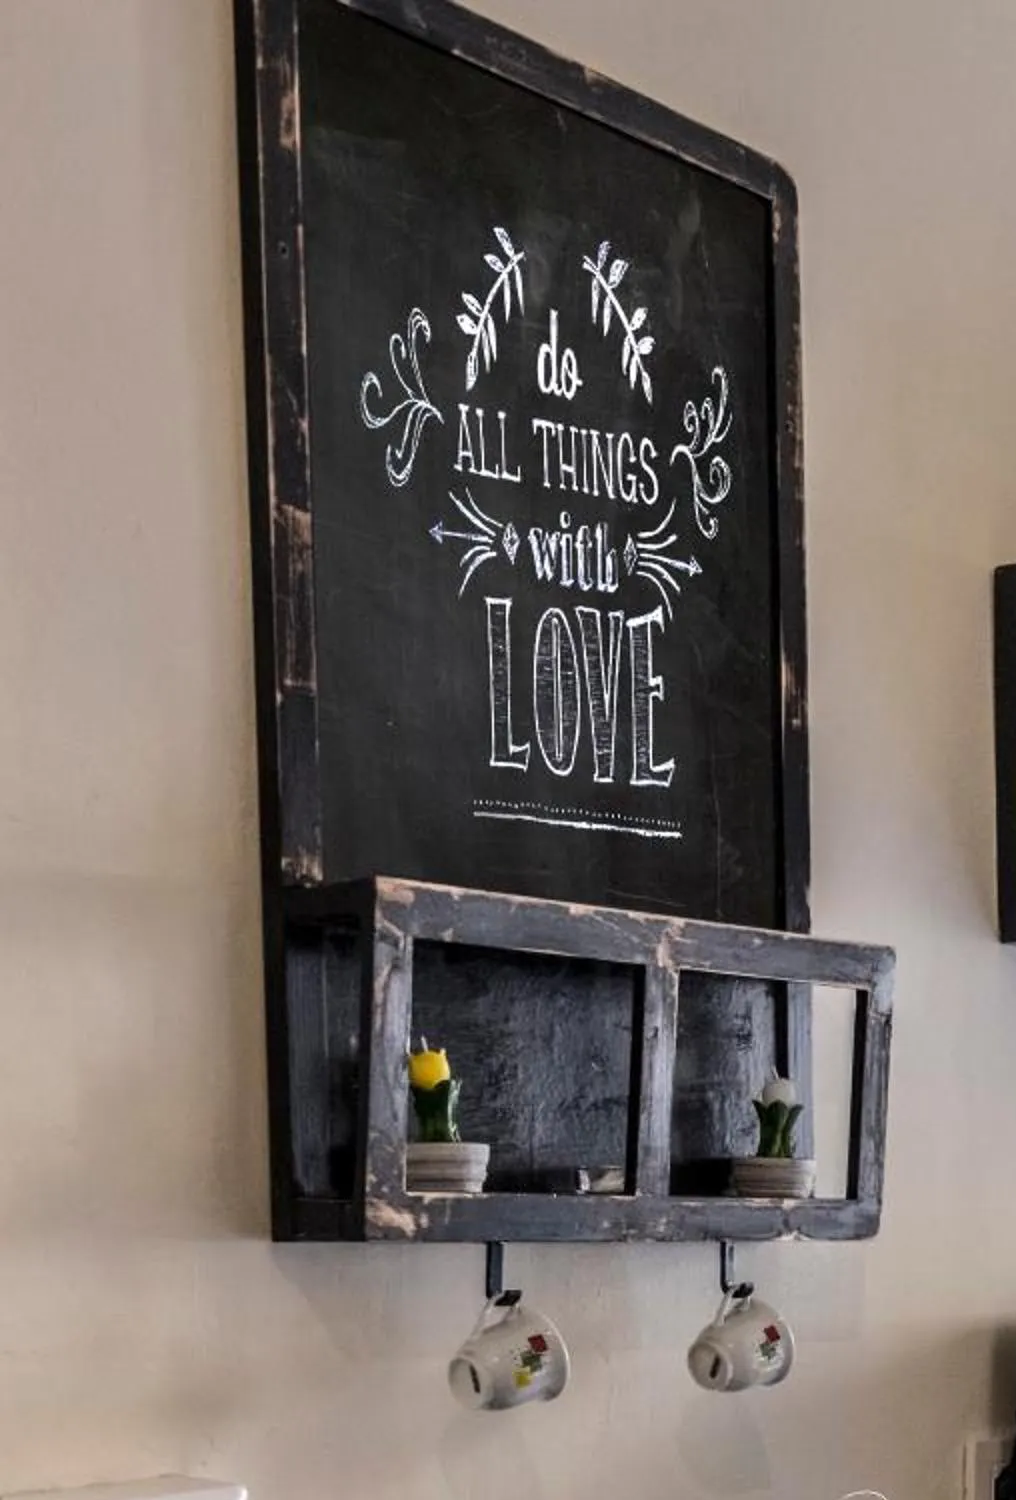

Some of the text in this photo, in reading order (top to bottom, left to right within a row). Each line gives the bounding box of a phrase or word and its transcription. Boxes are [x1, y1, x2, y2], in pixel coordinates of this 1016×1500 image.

[537, 309, 582, 400] do
[453, 404, 661, 505] ALL THINGS
[527, 511, 620, 593] with
[484, 596, 675, 788] LOVE
